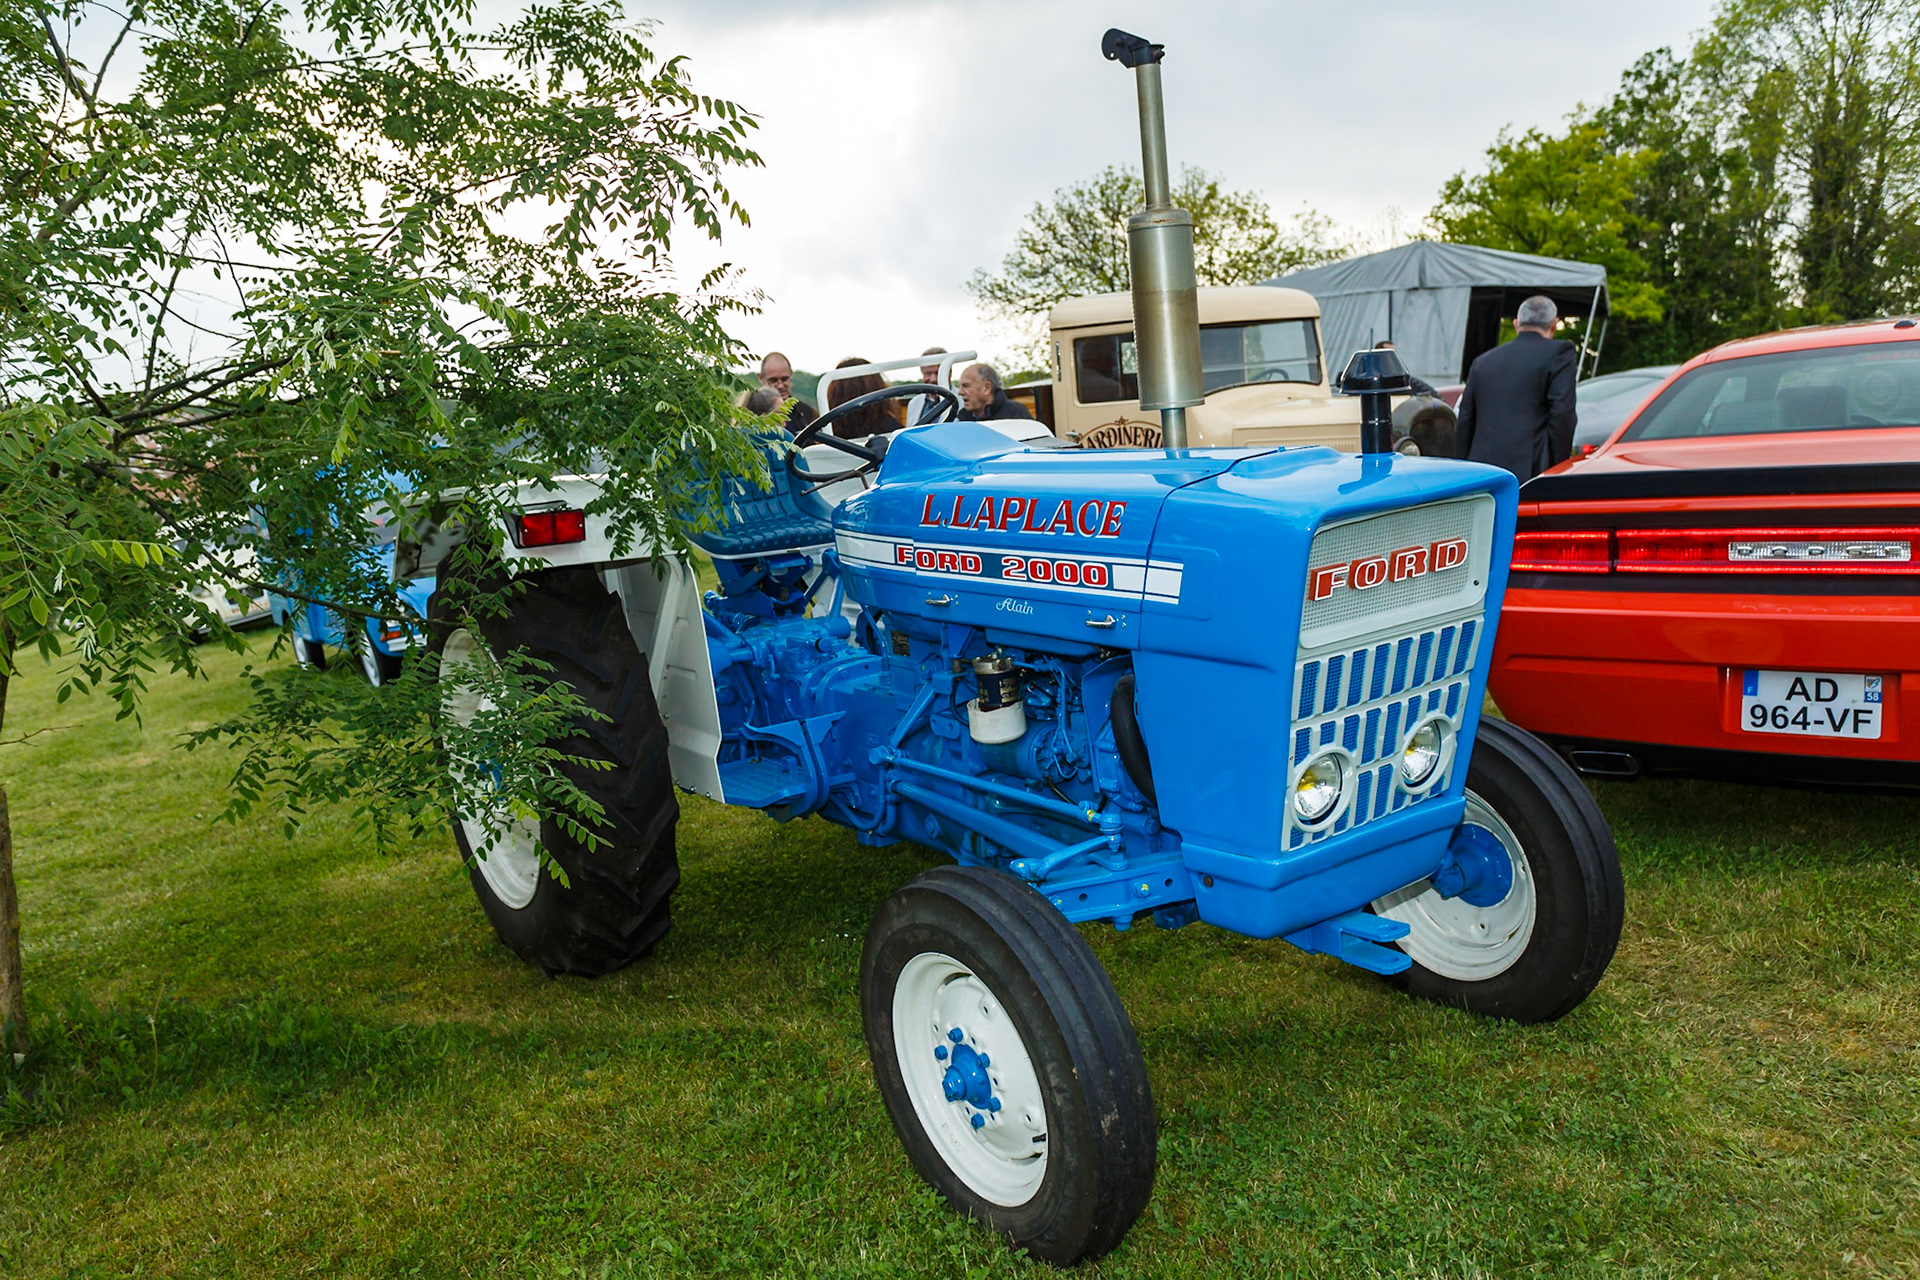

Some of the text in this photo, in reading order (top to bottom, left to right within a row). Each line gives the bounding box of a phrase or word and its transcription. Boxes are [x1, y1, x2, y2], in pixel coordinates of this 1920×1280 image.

[1080, 426, 1163, 448] ARDINERI
[919, 494, 1127, 538] L.LAPLACE
[896, 545, 1109, 588] FORD 2000
[1307, 537, 1468, 601] FORD
[996, 597, 1034, 615] Alain
[1785, 677, 1838, 702] AD
[1866, 692, 1879, 702] 58
[1750, 704, 1873, 734] 964-VF
